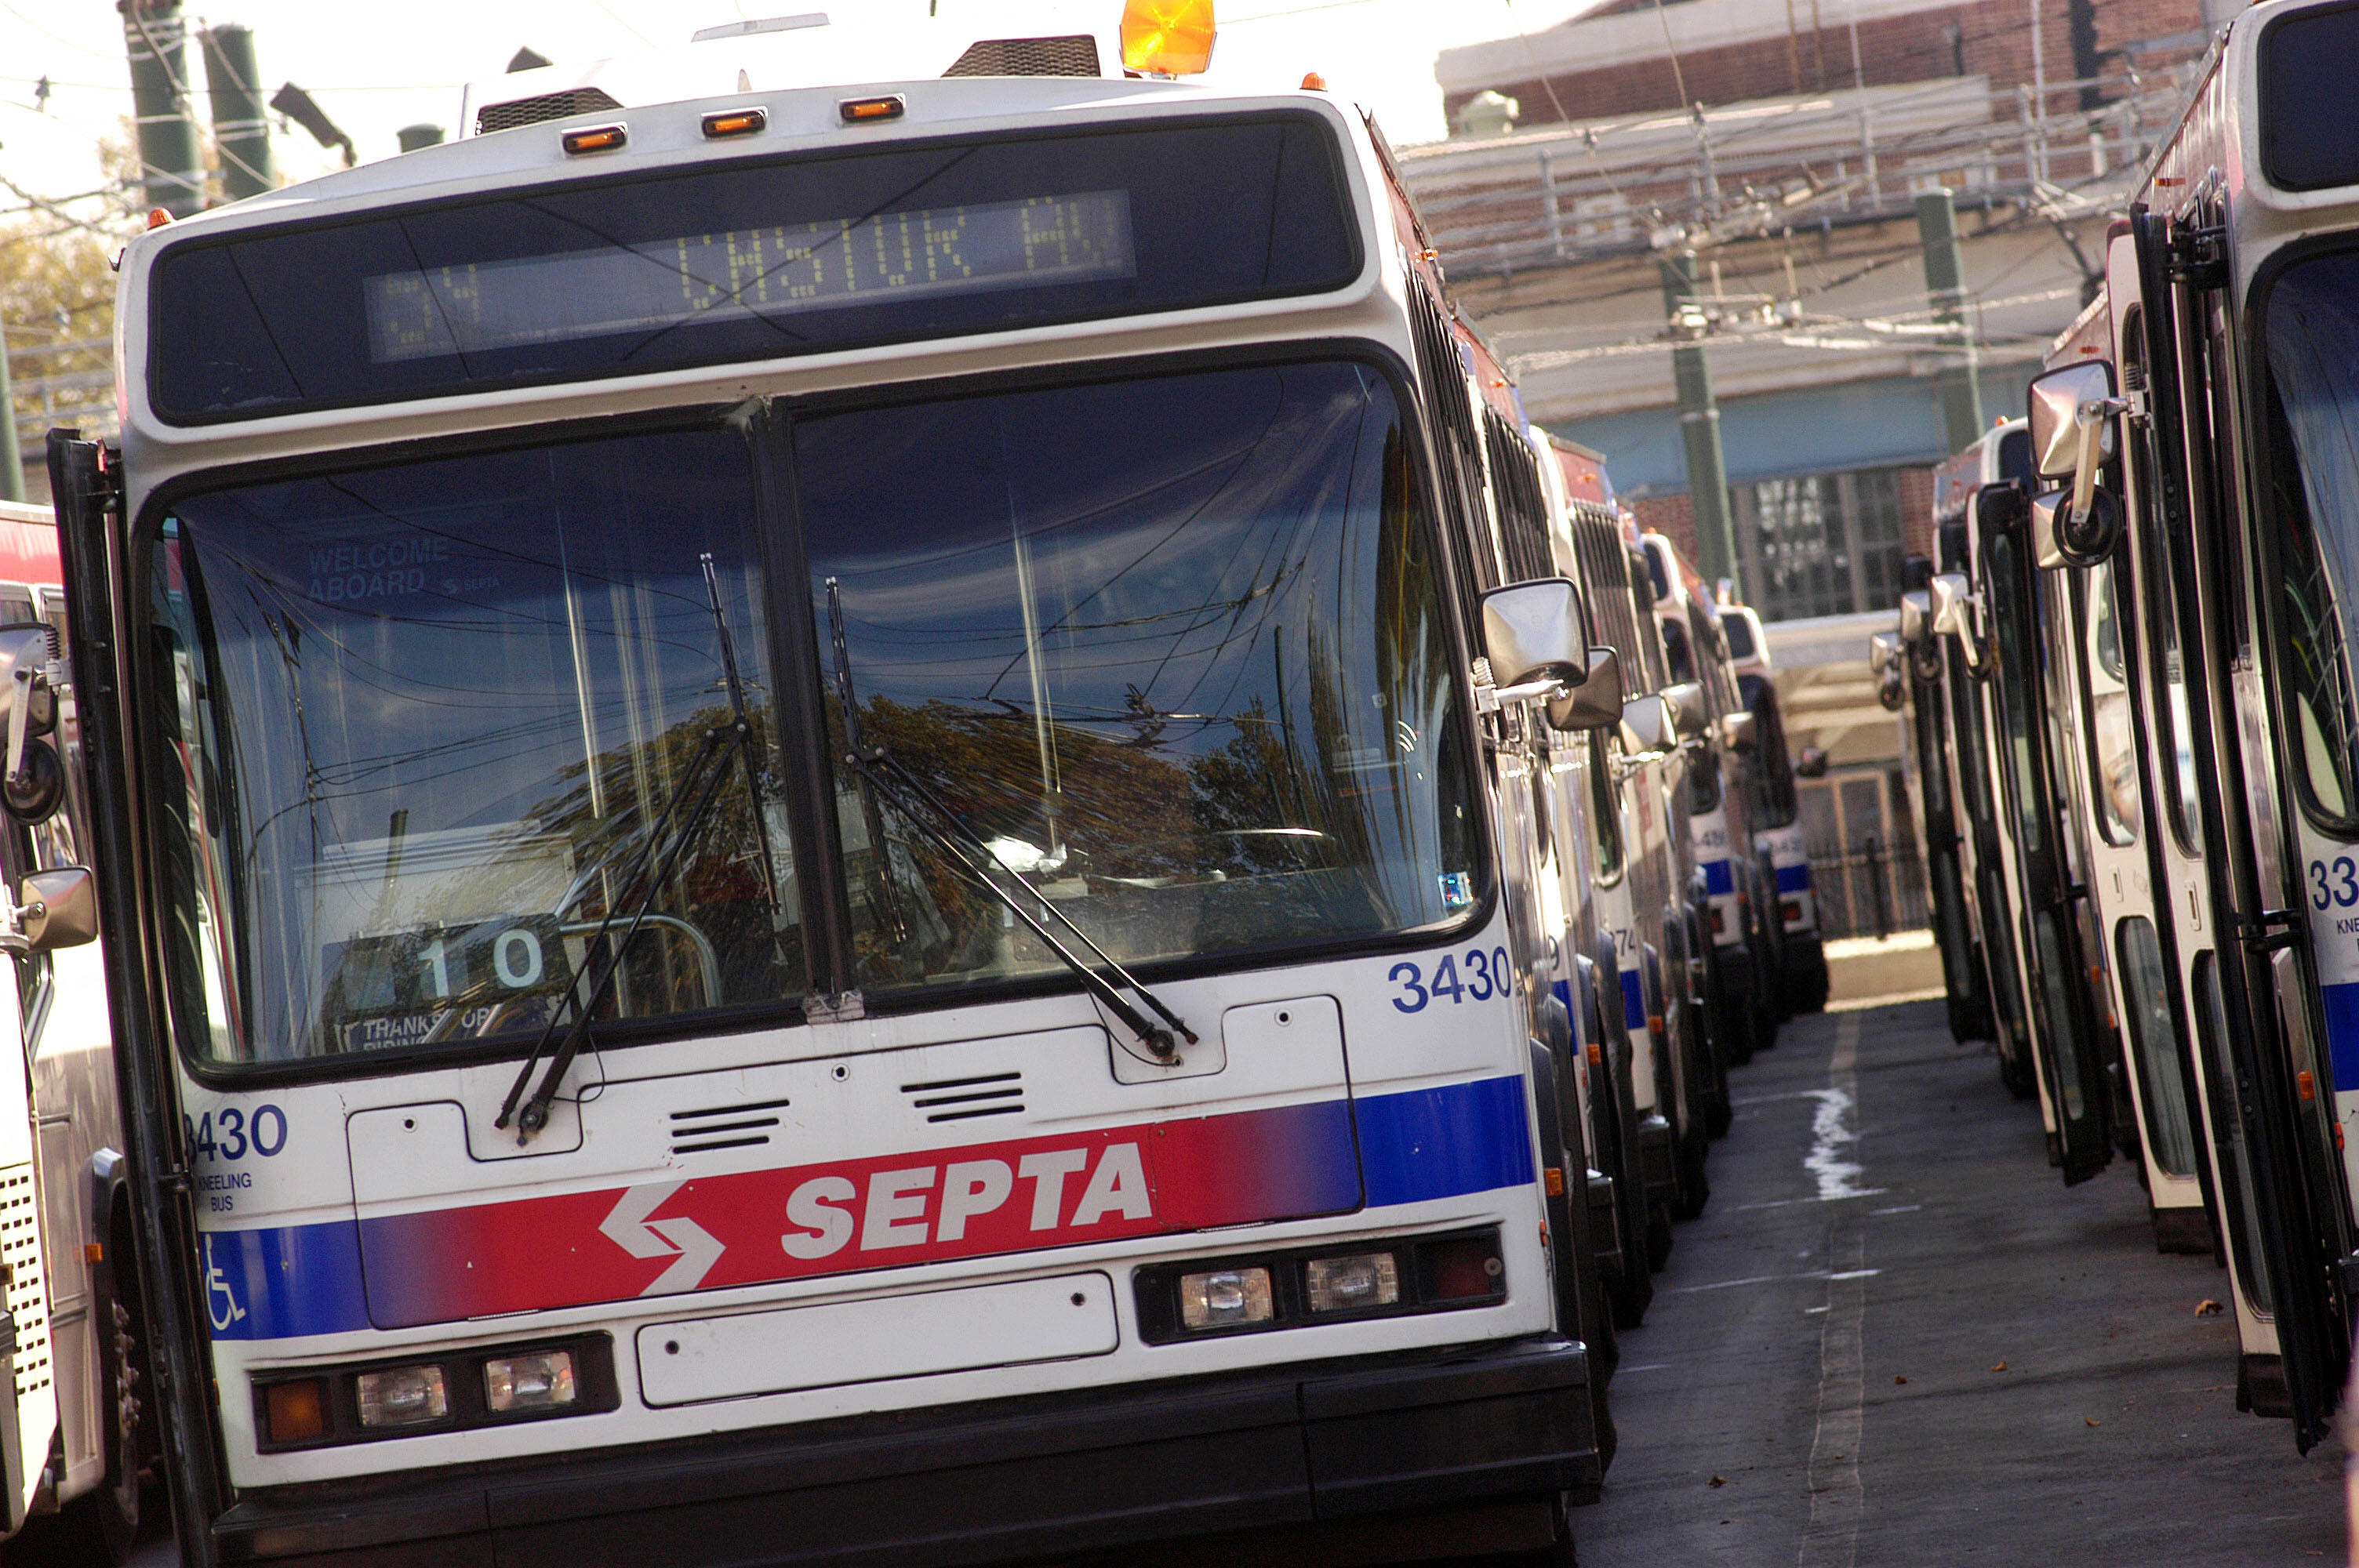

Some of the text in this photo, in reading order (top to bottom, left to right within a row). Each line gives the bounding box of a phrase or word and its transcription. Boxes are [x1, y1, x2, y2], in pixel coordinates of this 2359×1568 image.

[308, 537, 450, 574] WELCOME
[308, 568, 426, 602] ABOARD
[1387, 945, 1512, 1014] 3430
[211, 1195, 234, 1212] BUS
[780, 1141, 1153, 1261] SEPTA
